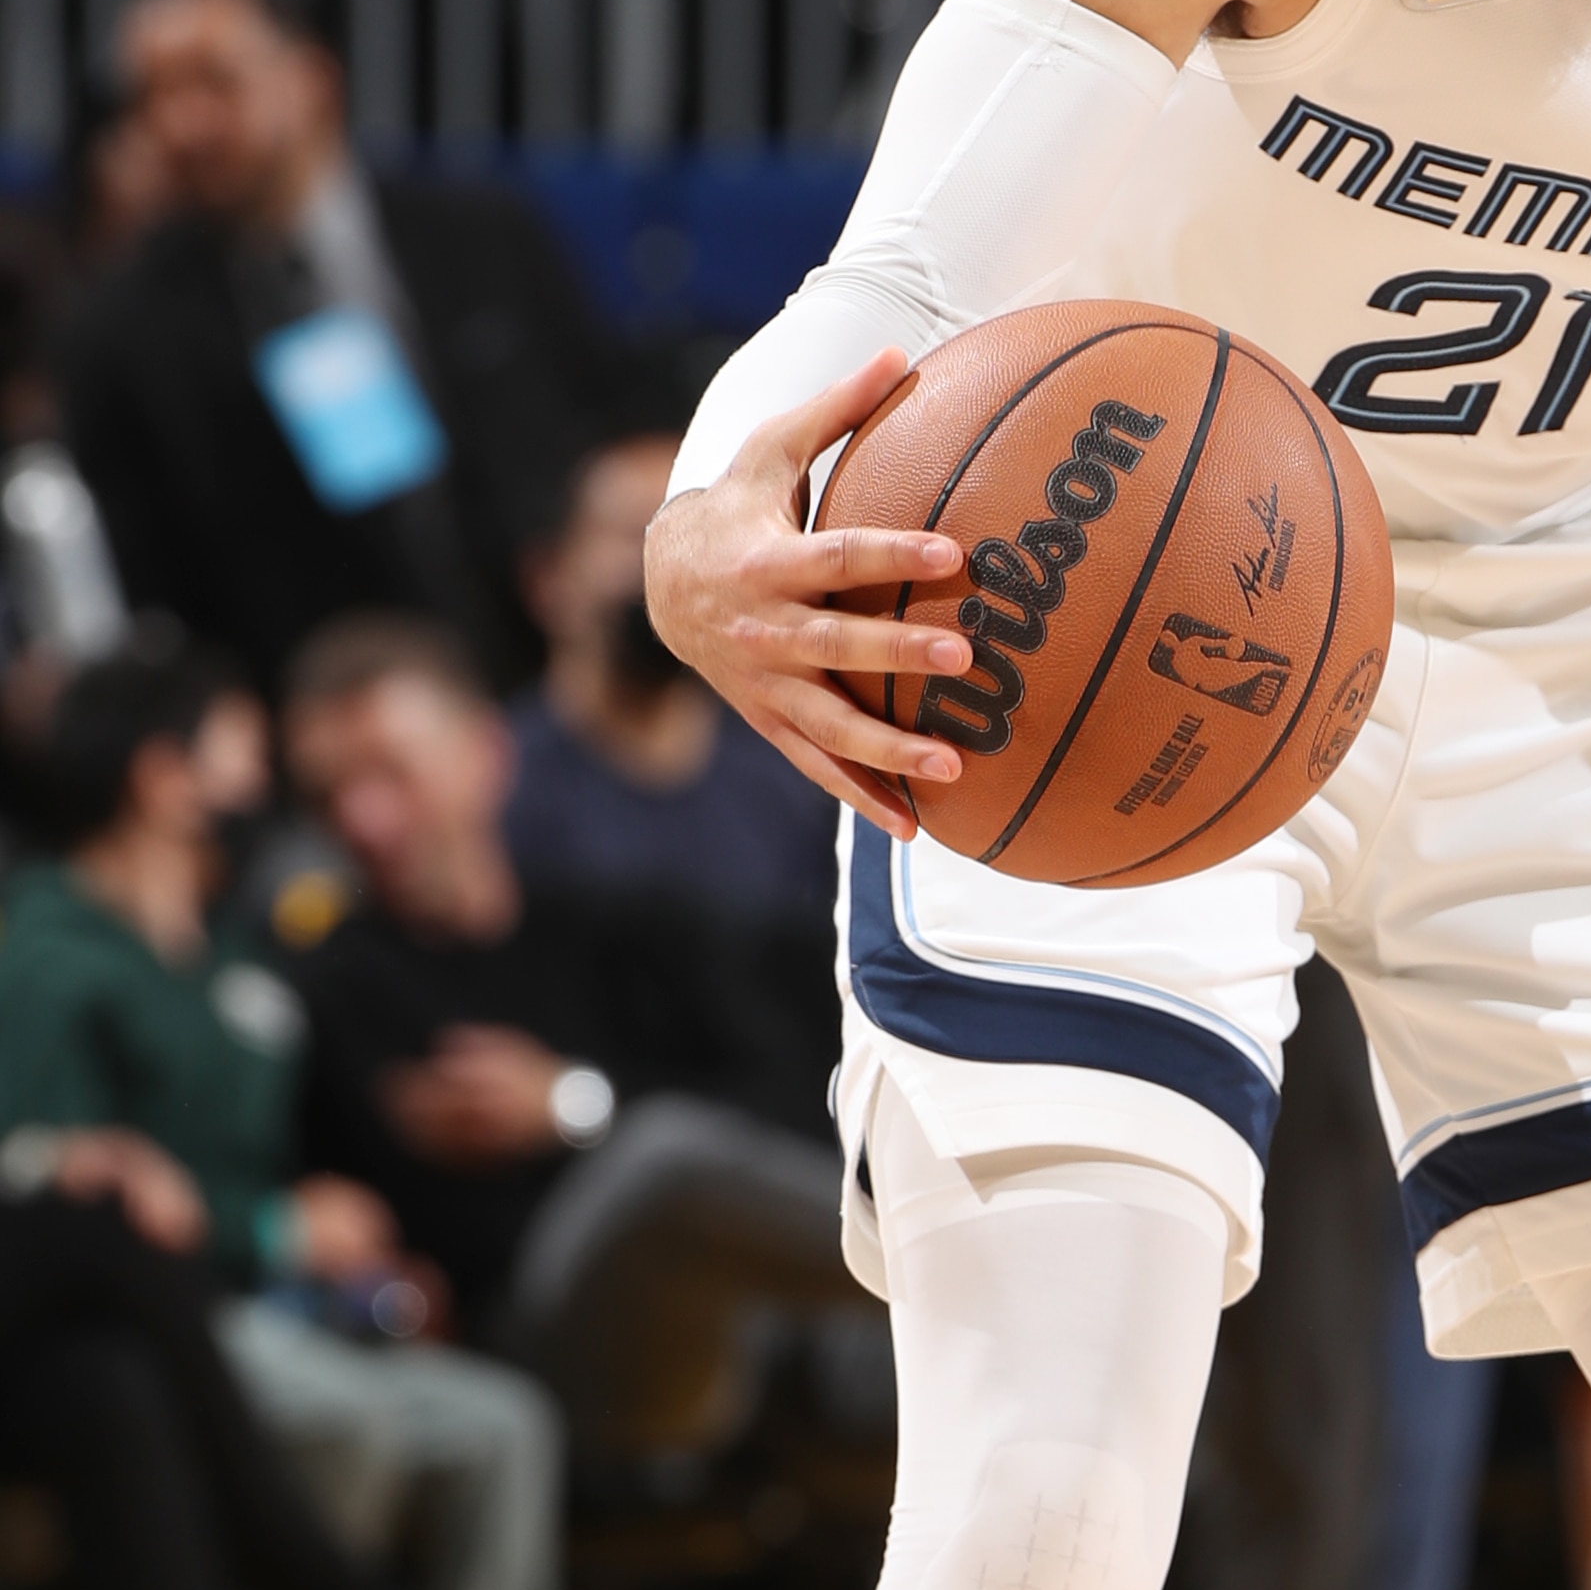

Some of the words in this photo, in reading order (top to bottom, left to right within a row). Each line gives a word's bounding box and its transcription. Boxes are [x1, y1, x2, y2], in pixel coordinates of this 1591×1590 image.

[916, 400, 1167, 755] Wilson
[1269, 519, 1295, 593] COMMISSIONER
[1251, 675, 1280, 708] NBA
[1114, 773, 1163, 815] OFFICIAL
[1150, 741, 1186, 774] GAME
[1173, 714, 1204, 743] BALL
[1176, 743, 1209, 777] LEATHER
